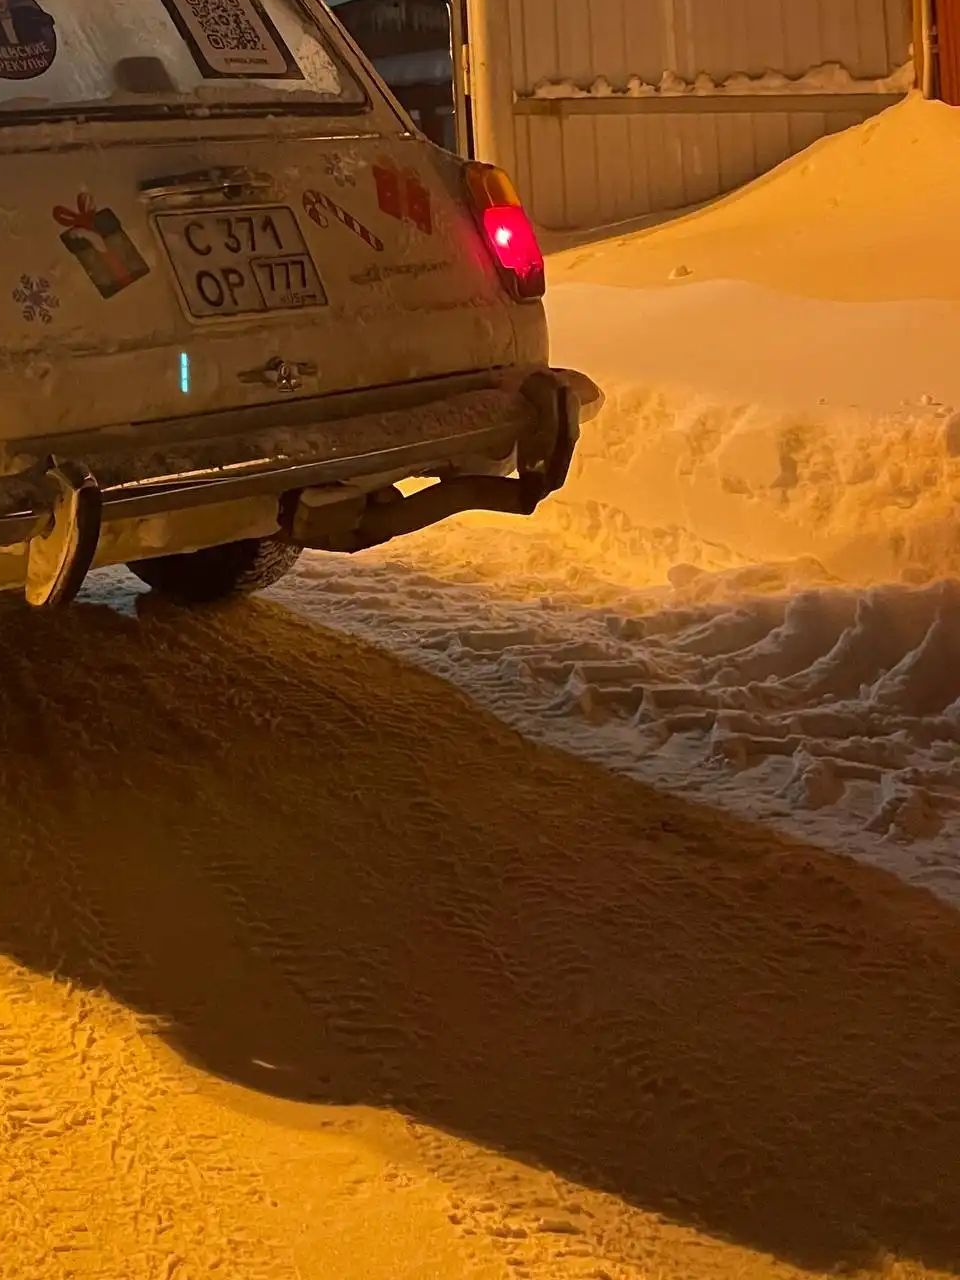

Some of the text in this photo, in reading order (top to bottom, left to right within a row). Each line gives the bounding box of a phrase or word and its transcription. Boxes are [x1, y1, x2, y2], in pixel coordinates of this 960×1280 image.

[217, 215, 283, 253] 371
[196, 268, 244, 307] ОР
[258, 261, 307, 291] 777
